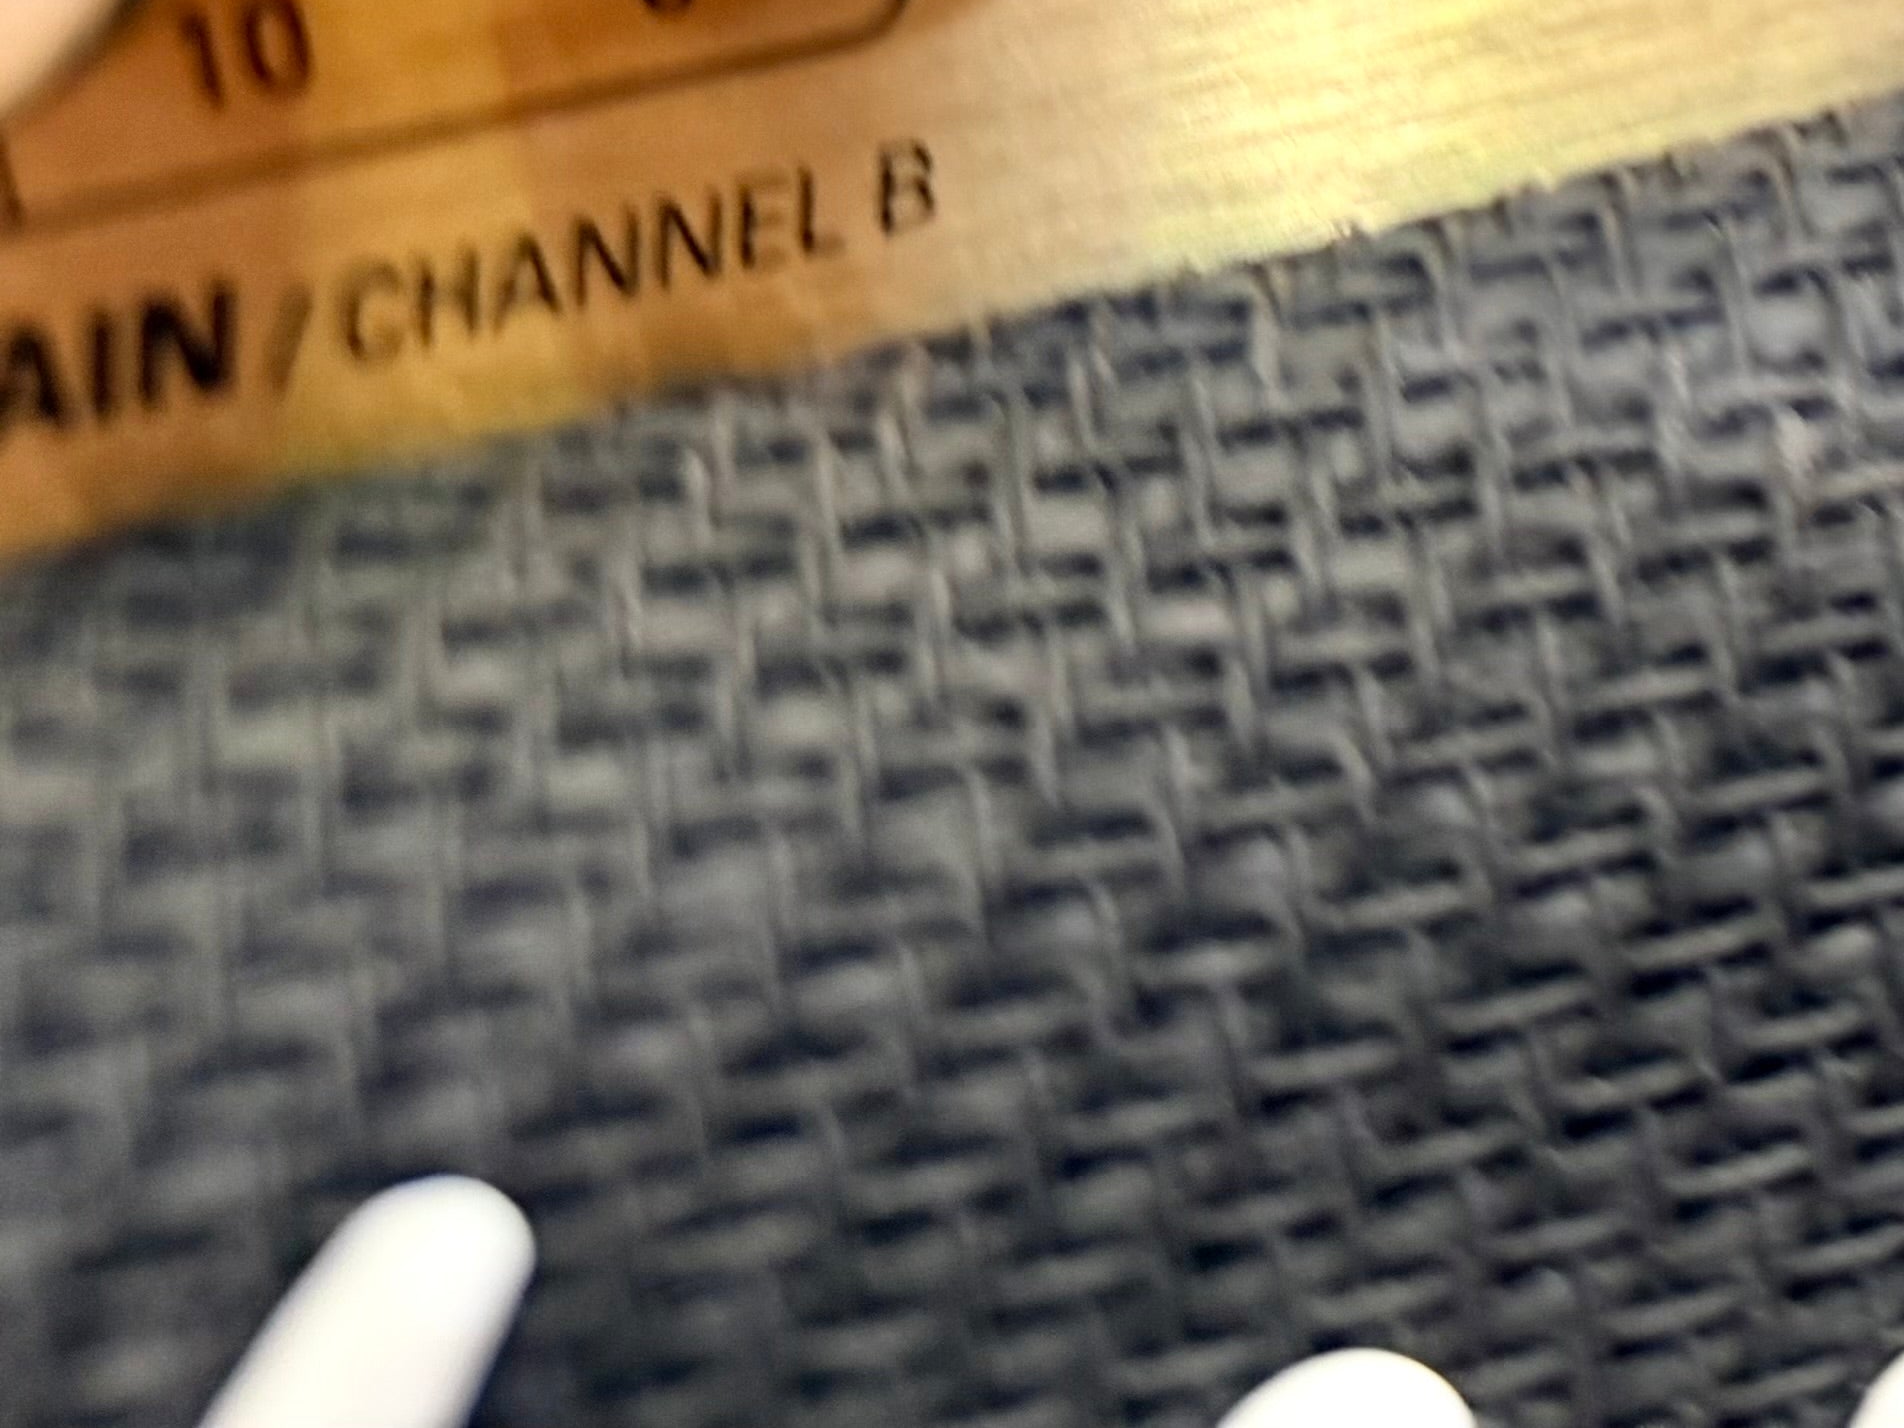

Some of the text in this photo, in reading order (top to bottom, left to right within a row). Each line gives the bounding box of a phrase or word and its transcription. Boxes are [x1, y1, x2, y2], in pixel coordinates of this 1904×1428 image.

[0, 279, 238, 434] AIN
[339, 165, 846, 365] CHANNEL
[876, 140, 937, 237] B
